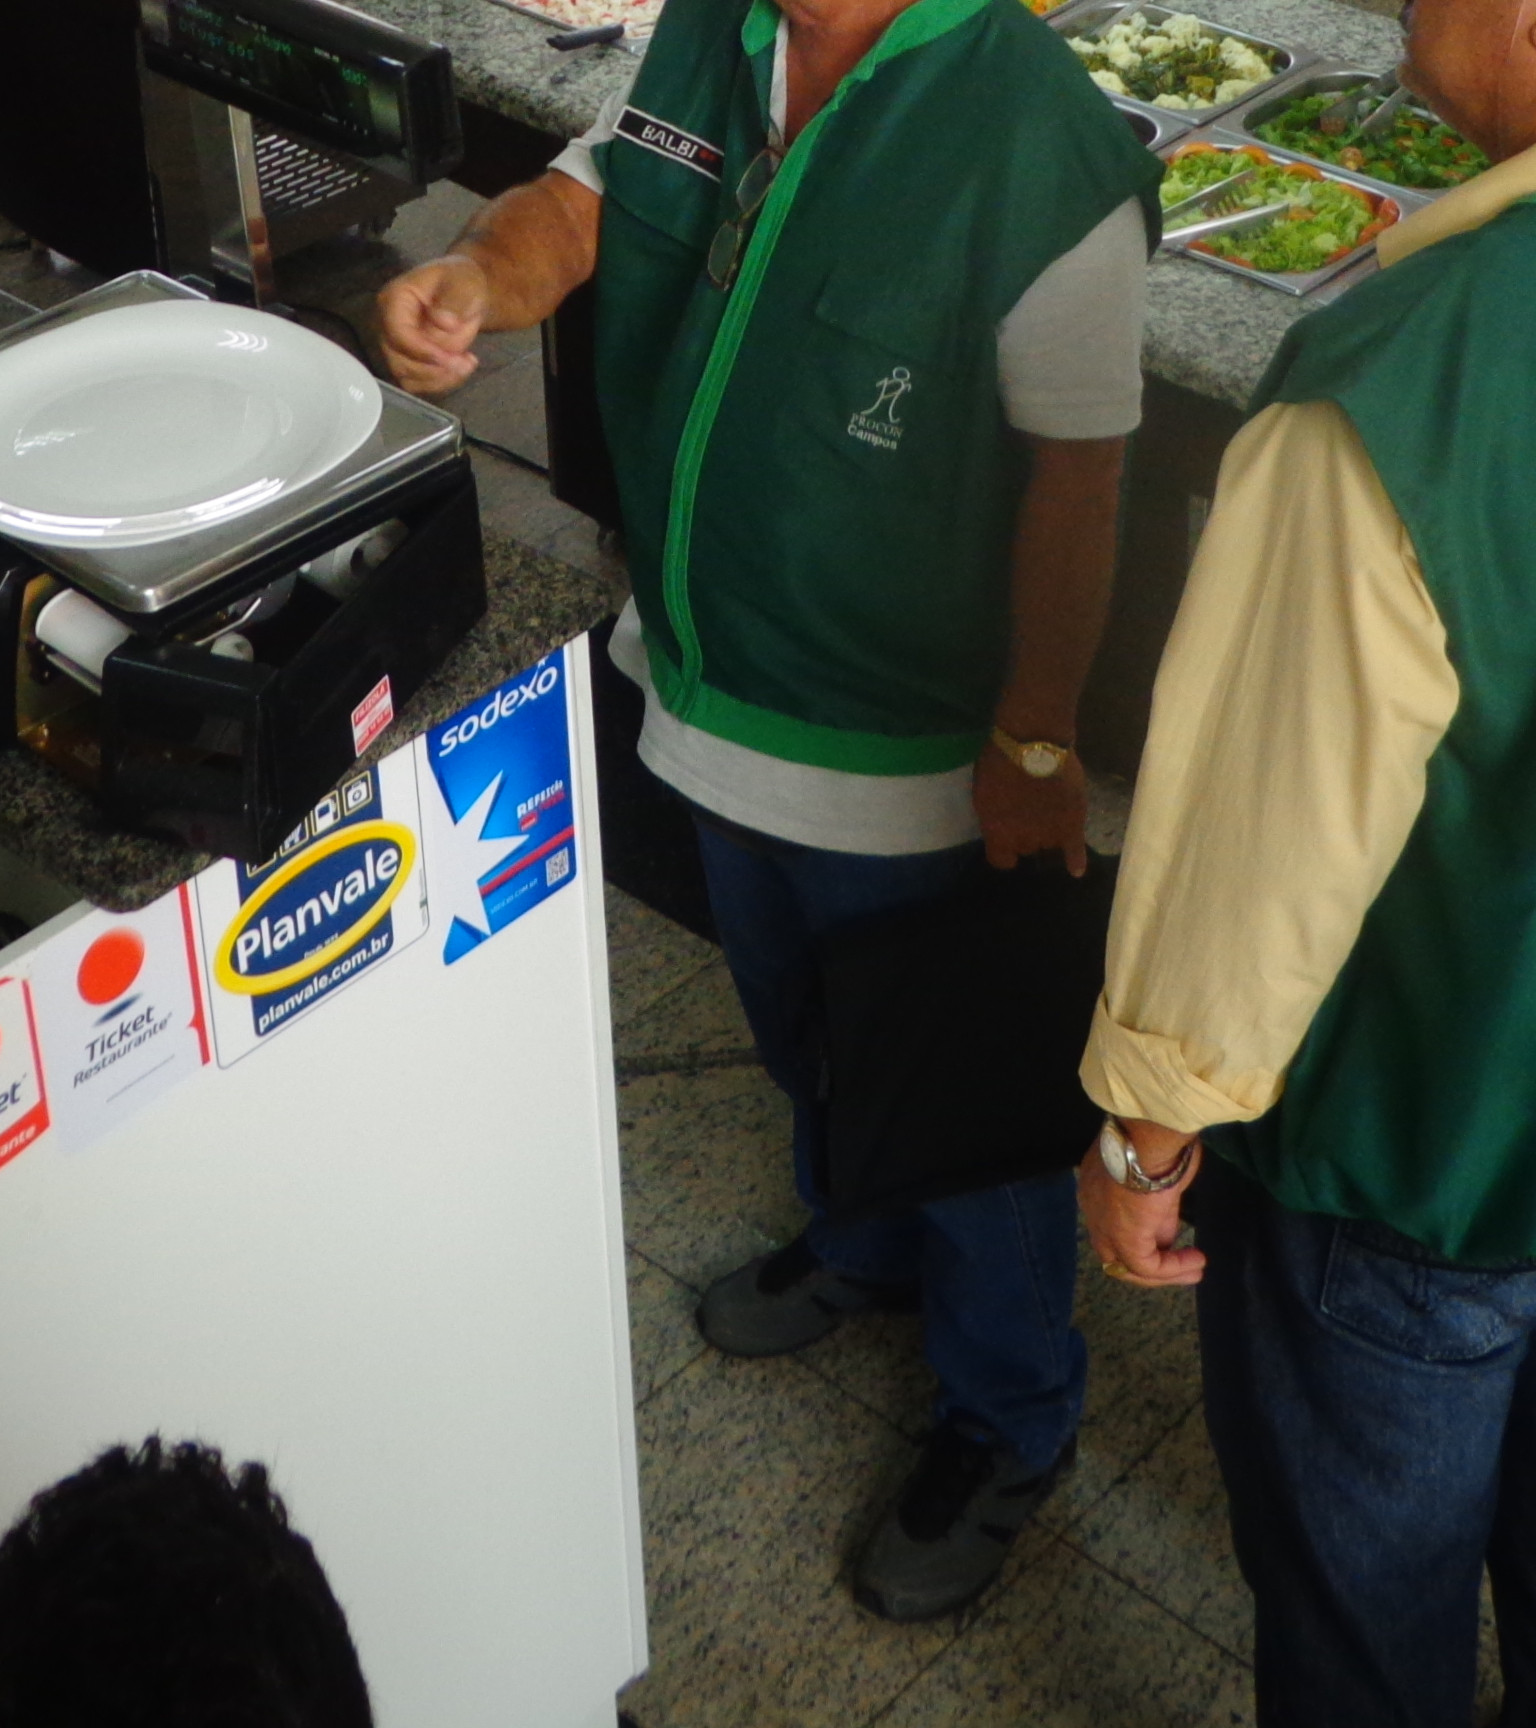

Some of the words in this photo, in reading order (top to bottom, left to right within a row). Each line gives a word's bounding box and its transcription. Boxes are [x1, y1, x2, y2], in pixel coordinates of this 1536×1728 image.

[640, 123, 699, 159] BALBI
[438, 659, 558, 758] sodexo
[235, 846, 400, 975] Planvale
[257, 932, 390, 1034] planvale.com.br
[72, 1017, 168, 1089] Restaurante
[84, 1005, 156, 1064] Ticket
